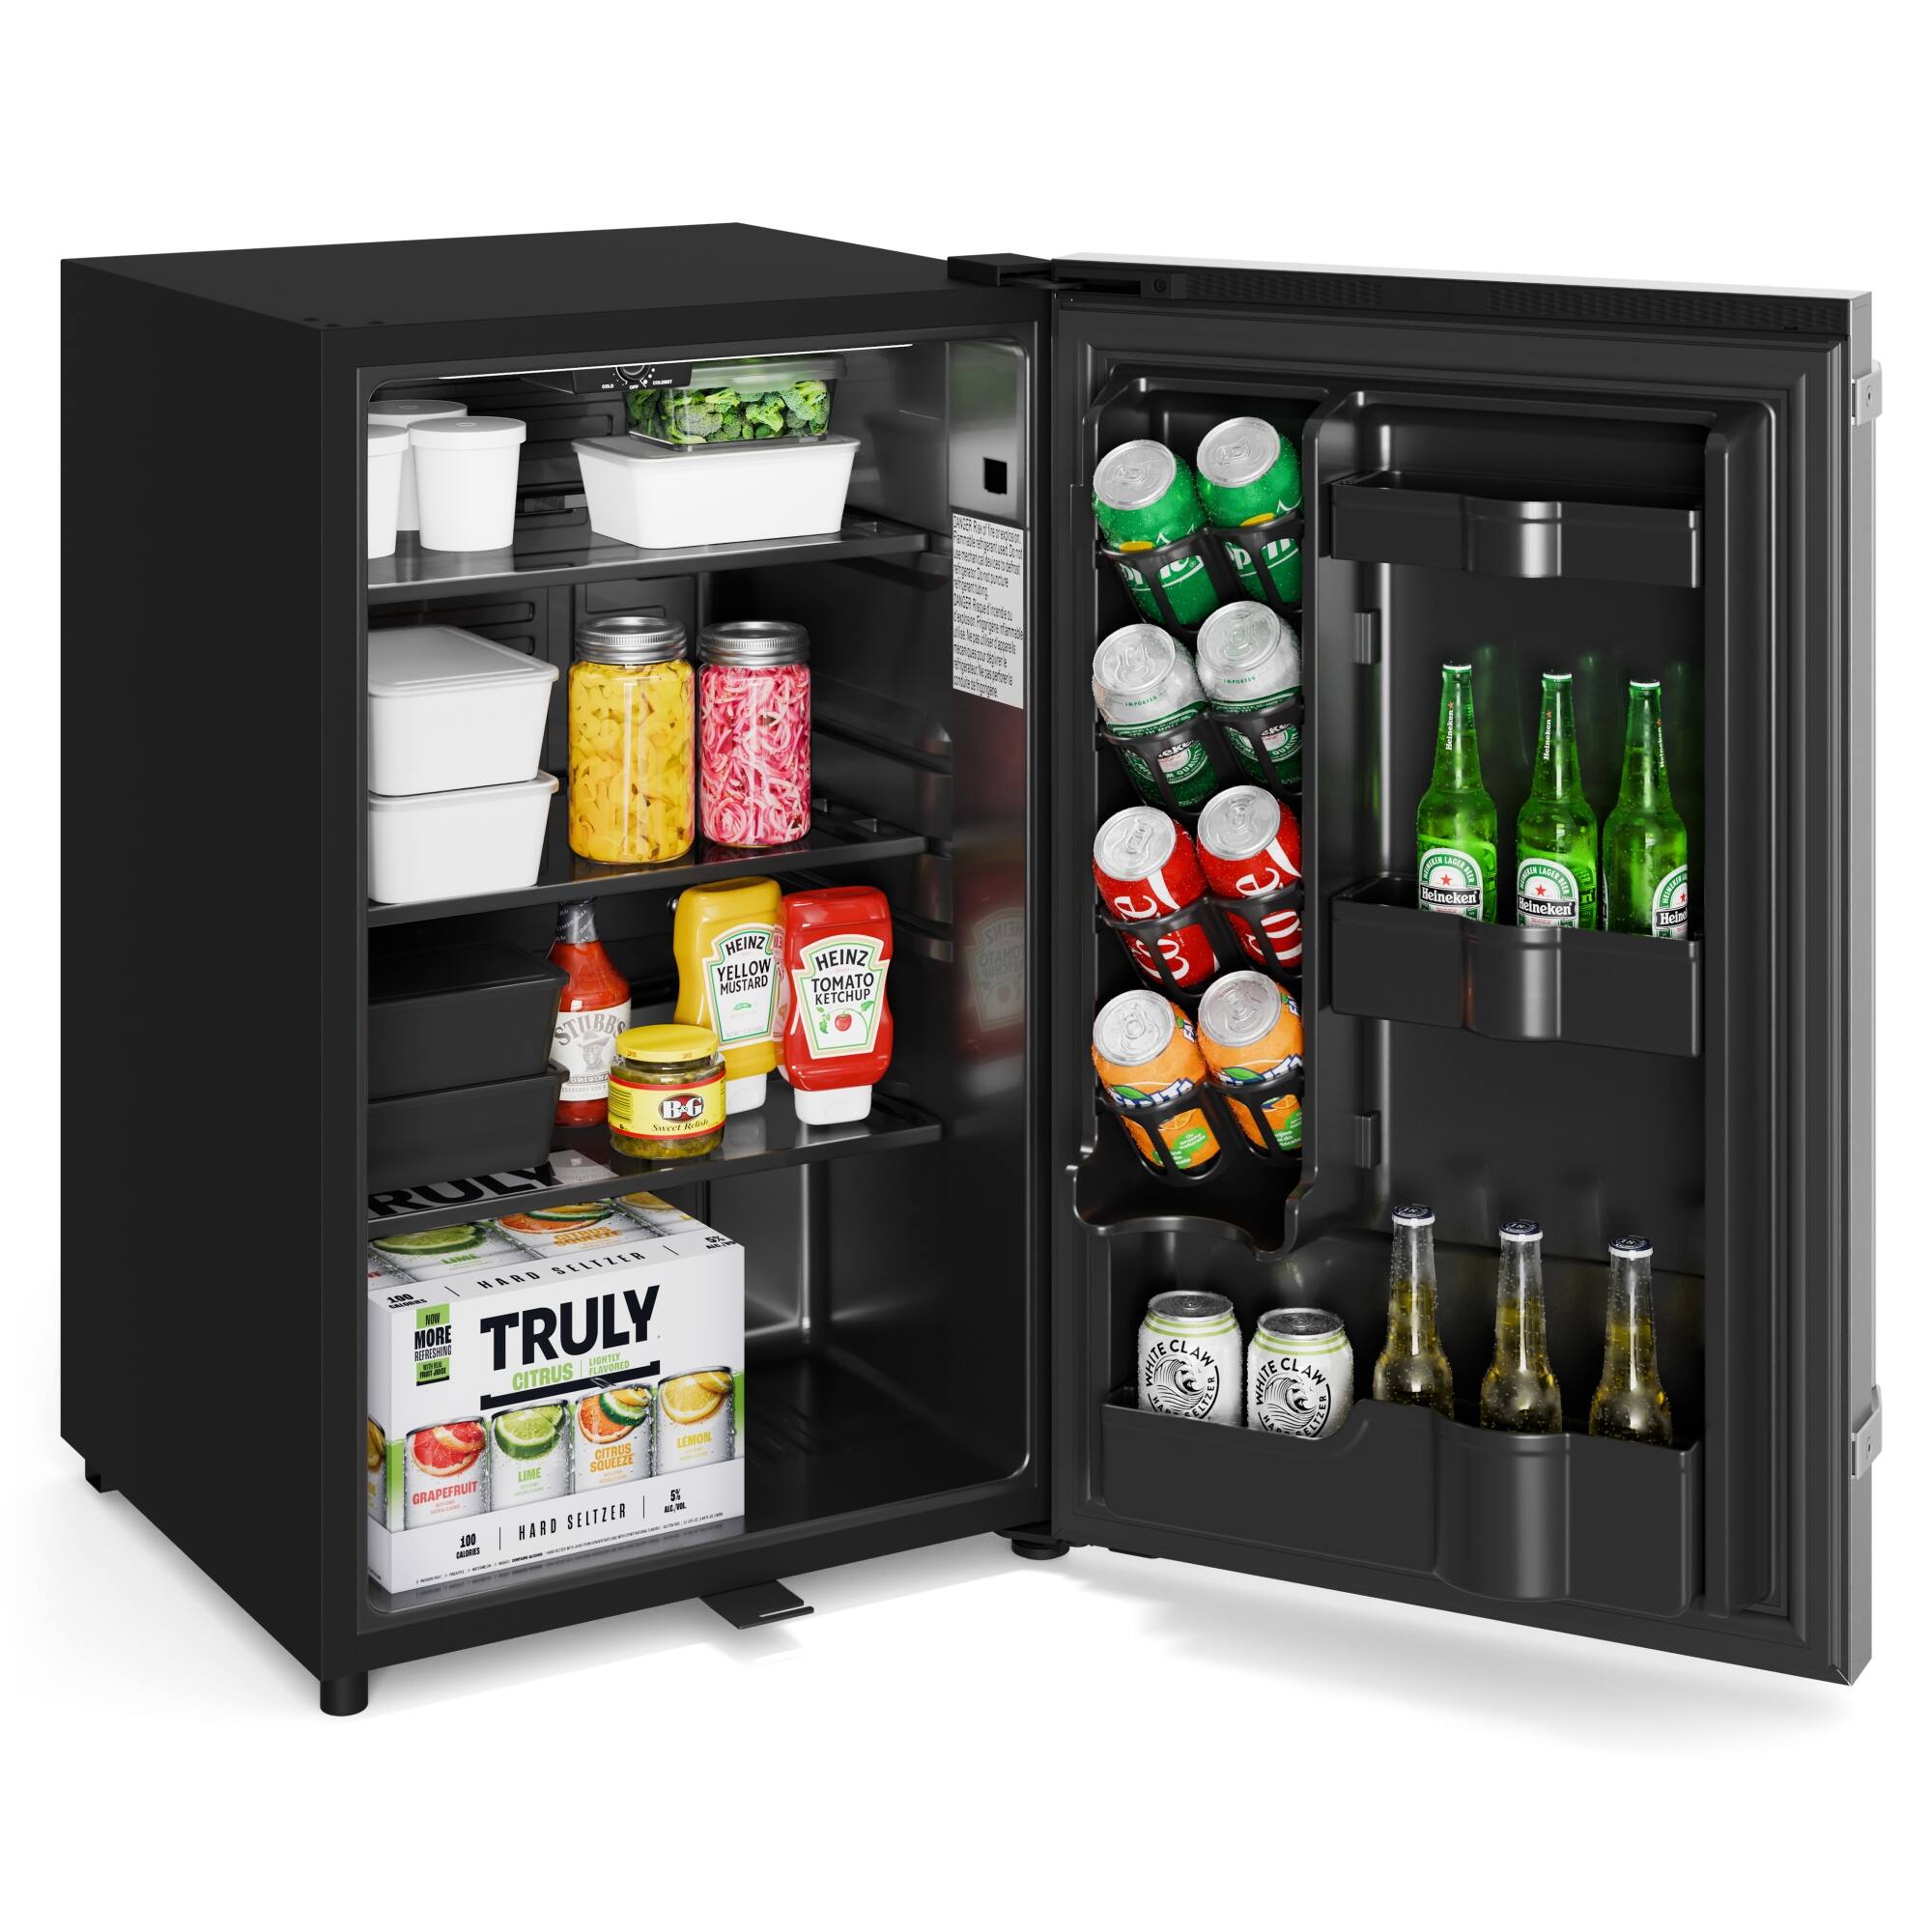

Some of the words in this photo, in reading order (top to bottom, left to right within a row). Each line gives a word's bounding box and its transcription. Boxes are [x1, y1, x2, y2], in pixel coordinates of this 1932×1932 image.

[1445, 710, 1454, 751] Heineken
[1423, 857, 1443, 879] HEINEKEN
[1444, 856, 1465, 869] LAGER
[1464, 866, 1475, 883] BEER
[1520, 867, 1538, 889] HEINEKEN
[1540, 867, 1559, 880] LAGER
[1558, 877, 1570, 895] BEER
[1422, 887, 1476, 904] Heineken
[1519, 896, 1572, 916] Heineken
[724, 935, 765, 956] HEINZ
[717, 958, 771, 982] YELLOW
[815, 949, 869, 972] HEINZ
[721, 974, 768, 995] MUSTARD
[811, 972, 874, 993] TOMATO
[815, 988, 870, 1005] KETCHUP
[662, 1097, 703, 1119] B&G
[684, 1120, 708, 1130] Relish
[368, 1161, 554, 1216] RULY
[704, 1235, 726, 1243] 5%
[476, 1271, 541, 1290] HARD
[551, 1252, 646, 1275] SELTZER
[386, 1293, 413, 1304] 100
[388, 1298, 428, 1309] CALORIES
[425, 1313, 440, 1325] NOW
[480, 1285, 661, 1372] TRULY
[414, 1325, 452, 1350] MORE
[414, 1345, 452, 1362] REFRESHING
[589, 1352, 622, 1366] LIGHTLY
[1145, 1342, 1167, 1387] WHITE
[1169, 1339, 1215, 1367] CLAW
[419, 1370, 433, 1378] FRUIT
[433, 1368, 446, 1377] JUICE
[512, 1362, 574, 1391] CITRUS
[589, 1360, 630, 1377] FLAVORED
[1256, 1360, 1277, 1405] WHITE
[1281, 1357, 1325, 1385] CLAW
[677, 1431, 712, 1449] LEMON
[594, 1443, 632, 1461] CITRUS
[589, 1453, 634, 1473] SQUEEZE
[518, 1466, 542, 1483] LIME
[412, 1480, 478, 1505] GRAPEFRUIT
[670, 1489, 681, 1502] 5%
[665, 1501, 688, 1514] ALC./VOL.
[518, 1518, 556, 1541] HARD
[567, 1503, 626, 1530] SELTZER
[460, 1533, 476, 1548] 100
[456, 1548, 480, 1559] CALORIES
